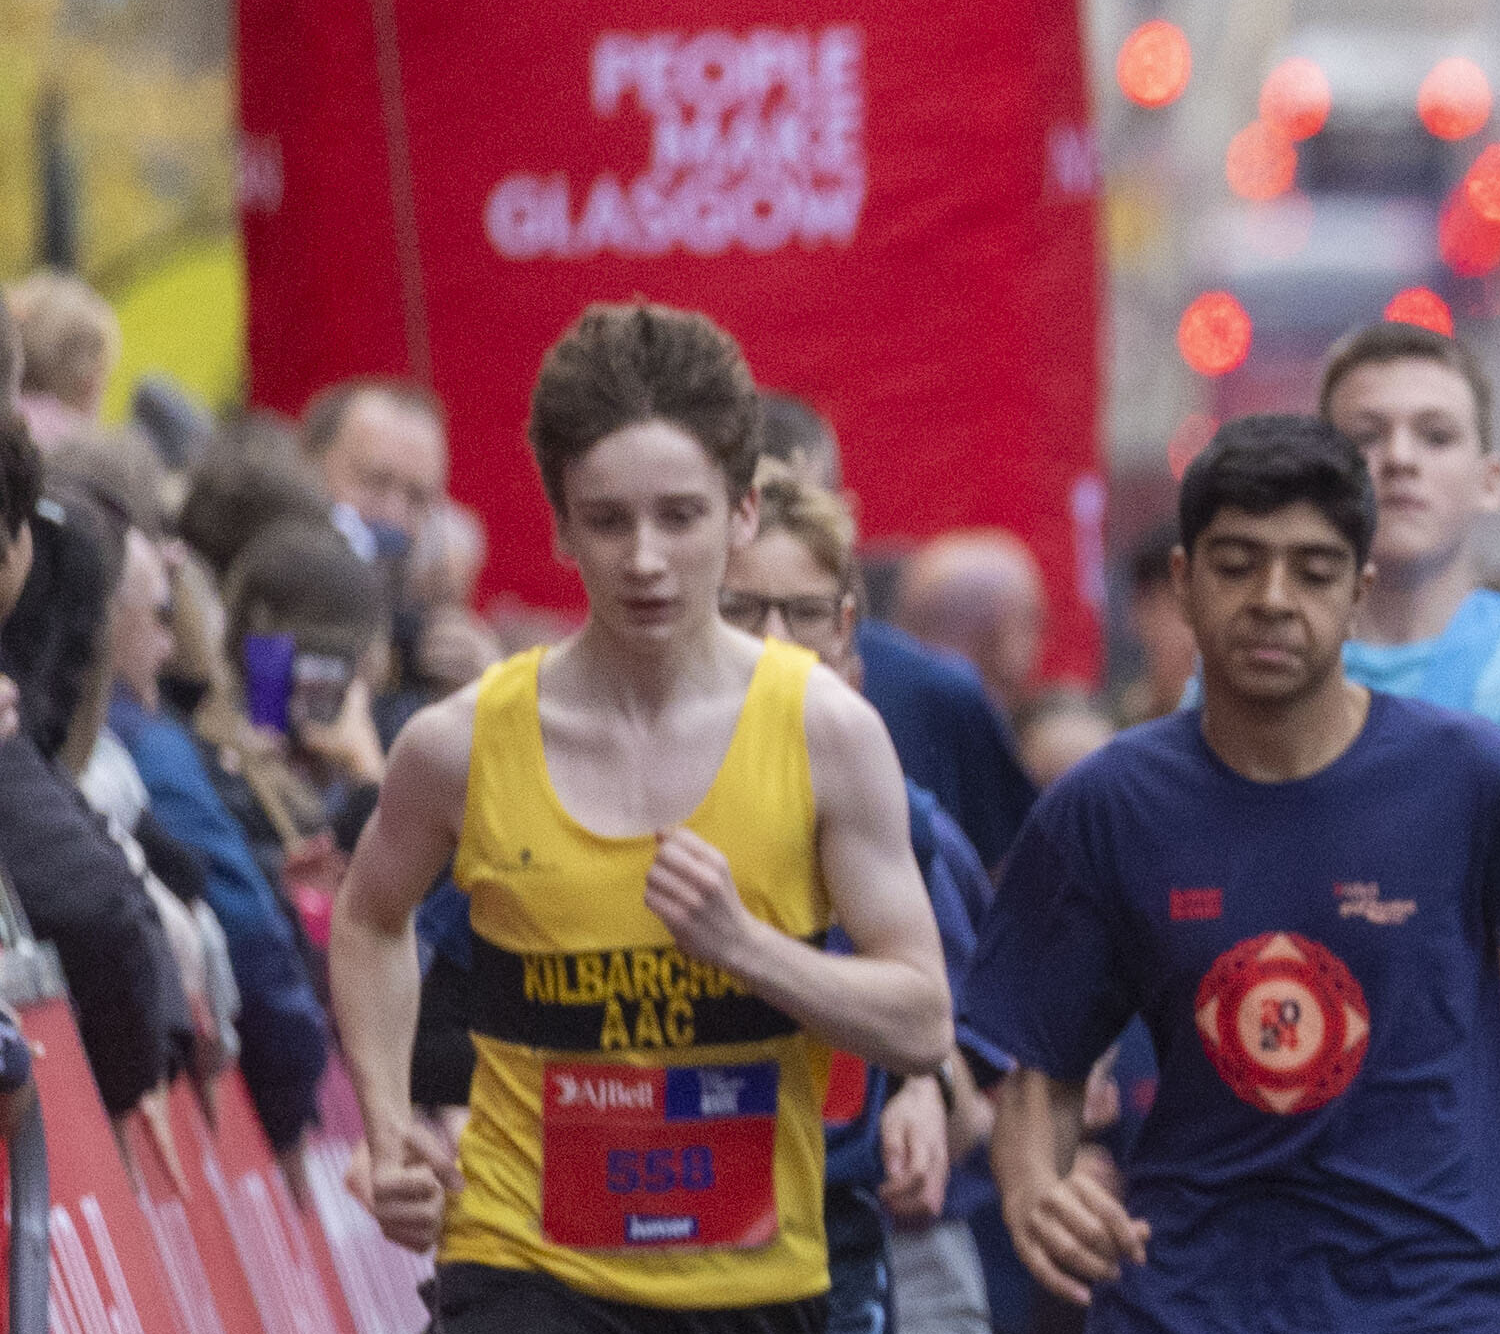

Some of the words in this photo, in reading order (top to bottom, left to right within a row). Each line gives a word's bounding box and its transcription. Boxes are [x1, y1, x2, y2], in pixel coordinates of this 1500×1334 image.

[590, 25, 868, 117] PEOPLE
[485, 169, 869, 259] GLASGOW
[601, 997, 696, 1051] AAC
[580, 1077, 655, 1112] AJBell
[605, 1144, 715, 1195] 558
